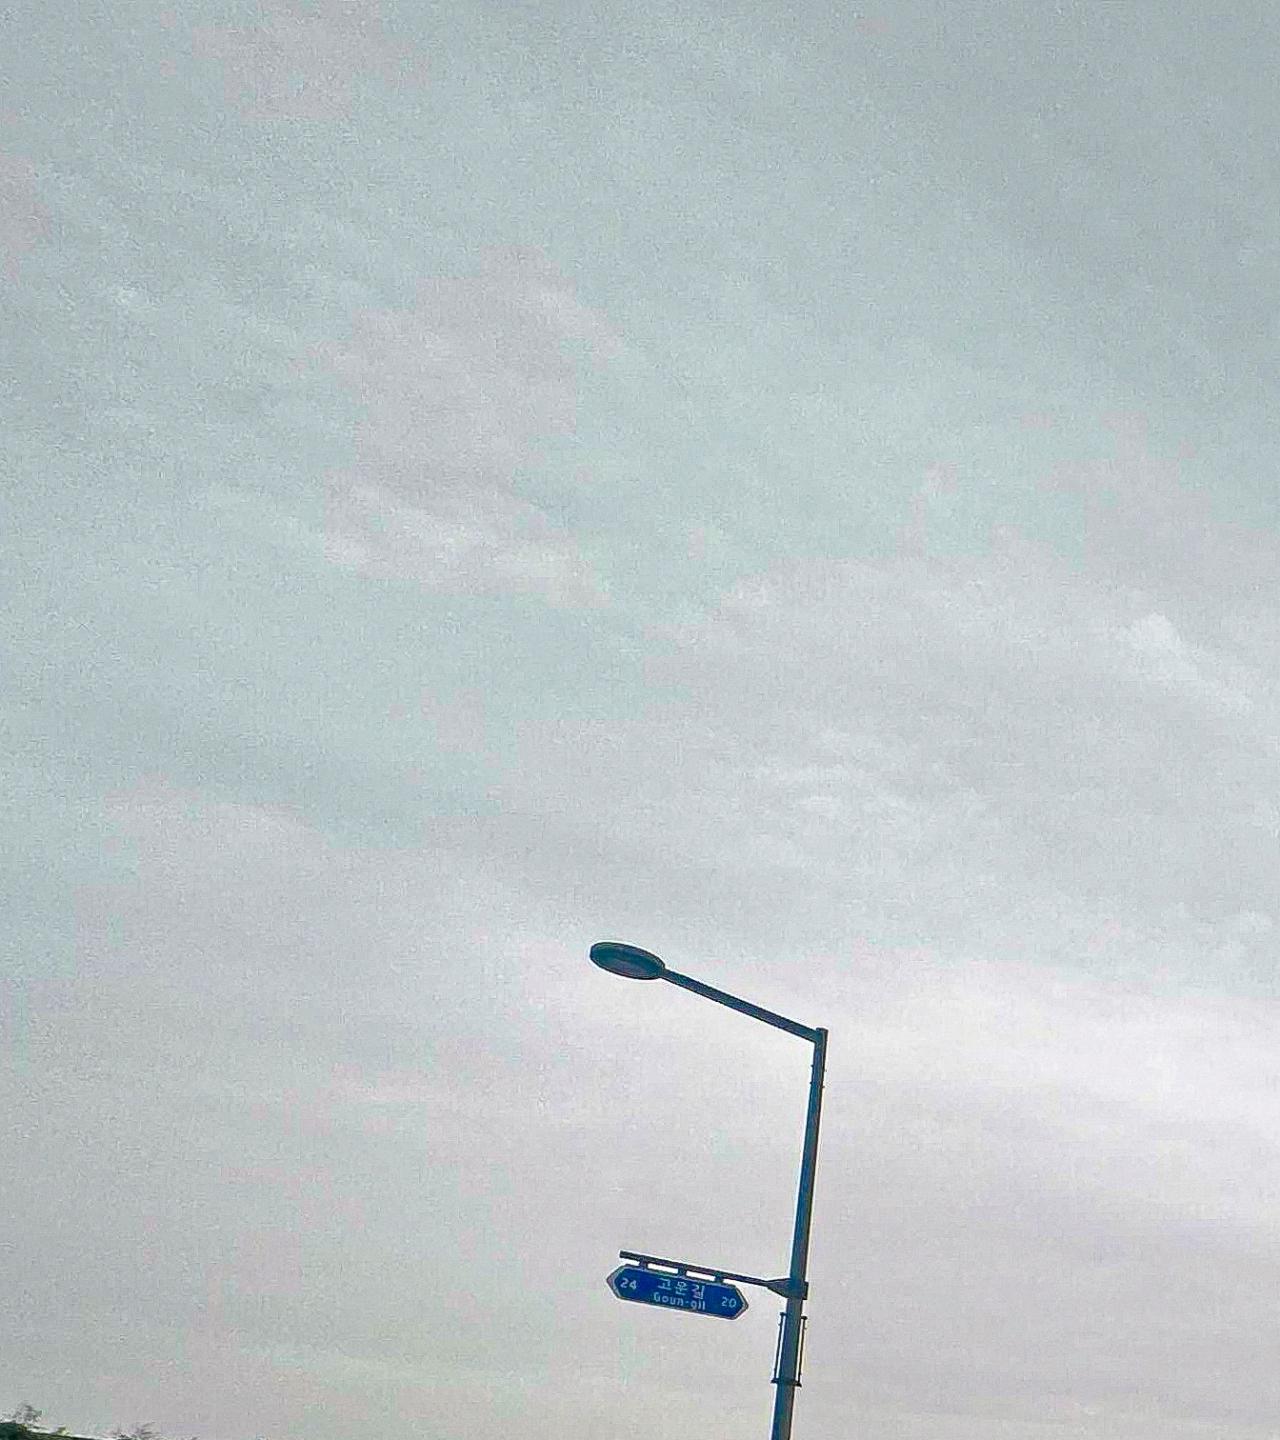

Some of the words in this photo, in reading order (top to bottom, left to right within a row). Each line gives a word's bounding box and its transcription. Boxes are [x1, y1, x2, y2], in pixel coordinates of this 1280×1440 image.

[620, 1278, 638, 1290] 24
[653, 1291, 706, 1310] Goun-gil
[721, 1296, 737, 1307] 20
